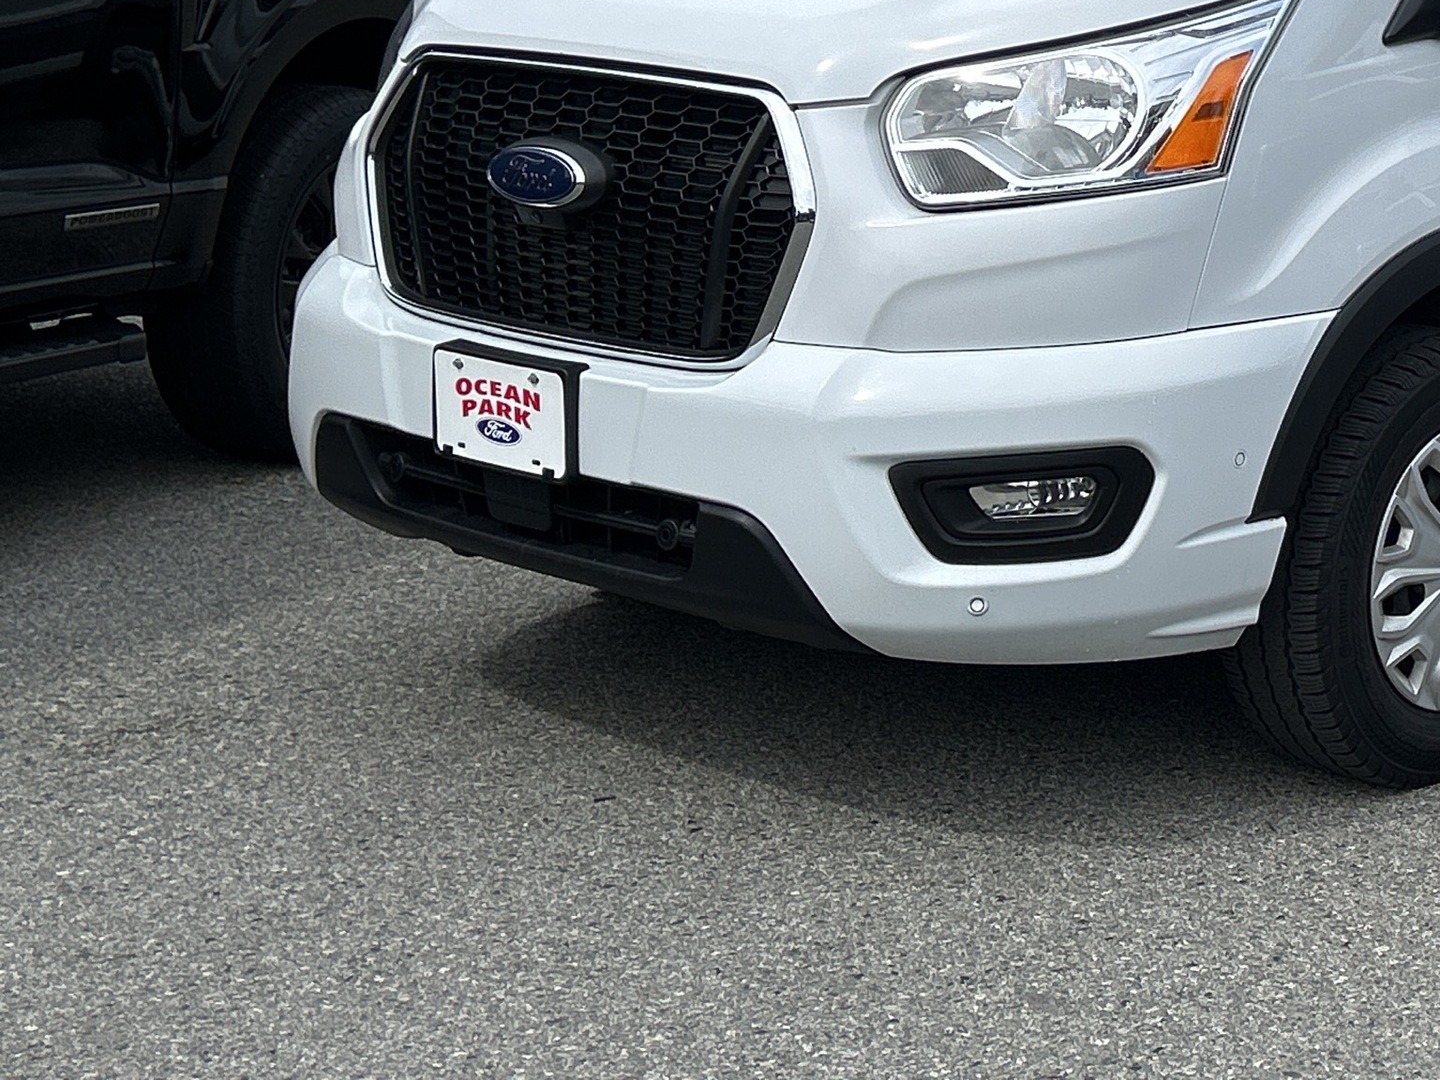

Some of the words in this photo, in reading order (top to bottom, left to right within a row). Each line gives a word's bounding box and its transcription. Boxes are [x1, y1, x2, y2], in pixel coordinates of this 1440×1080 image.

[502, 153, 557, 191] Ford
[455, 377, 541, 412] OCEAN
[462, 399, 532, 430] PARK
[484, 420, 514, 442] Ford
